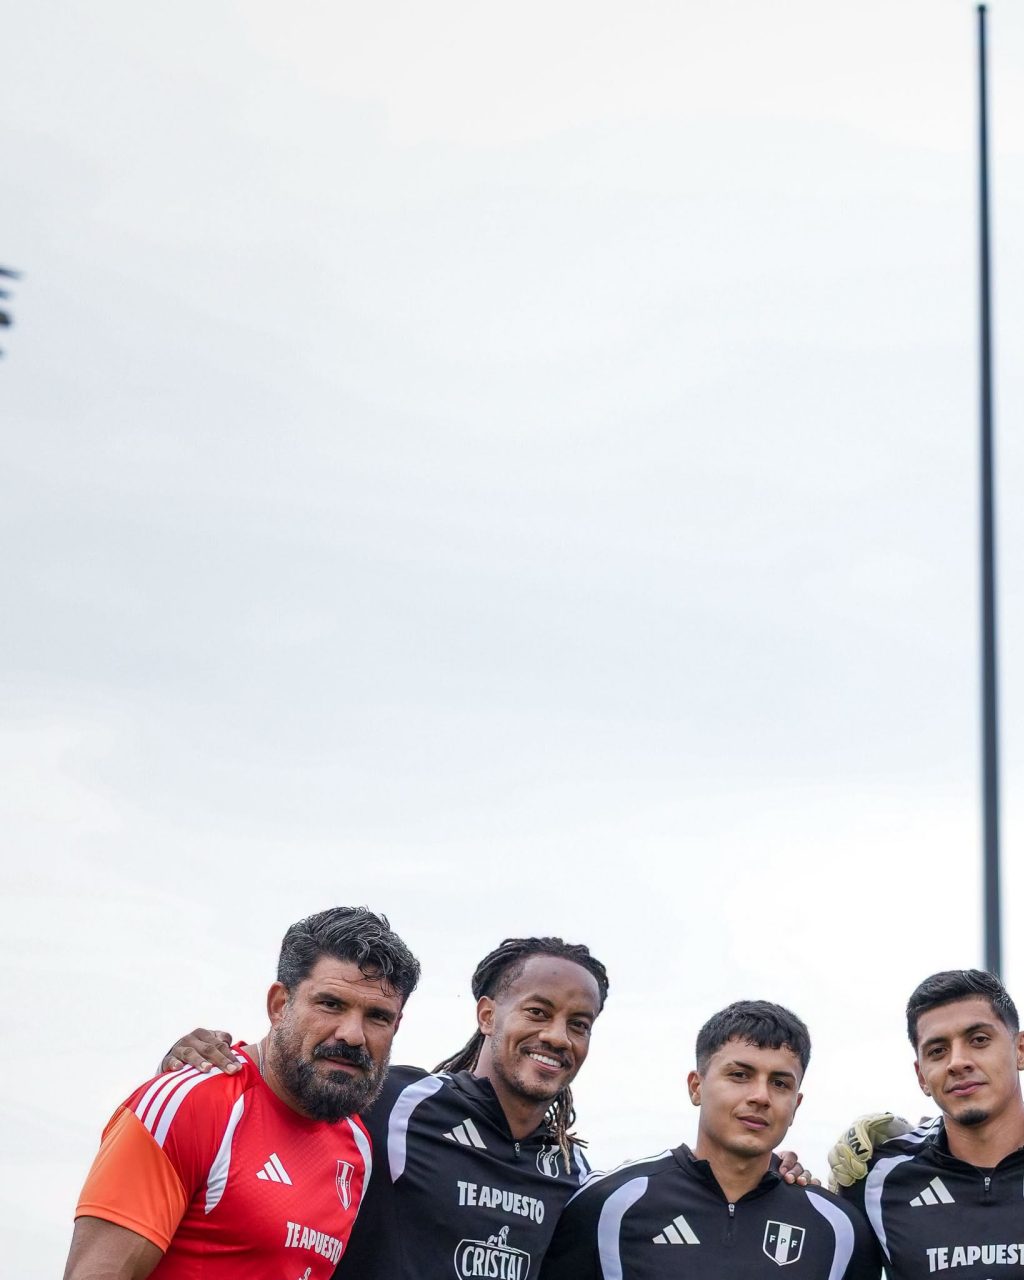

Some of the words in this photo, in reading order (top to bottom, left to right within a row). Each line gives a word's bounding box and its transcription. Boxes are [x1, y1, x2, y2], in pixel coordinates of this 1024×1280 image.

[457, 1180, 477, 1206] TE
[478, 1186, 545, 1225] APUESTO
[284, 1221, 300, 1248] TE
[300, 1226, 343, 1266] APUESTO
[769, 1234, 798, 1249] FPF
[926, 1247, 949, 1273] TE
